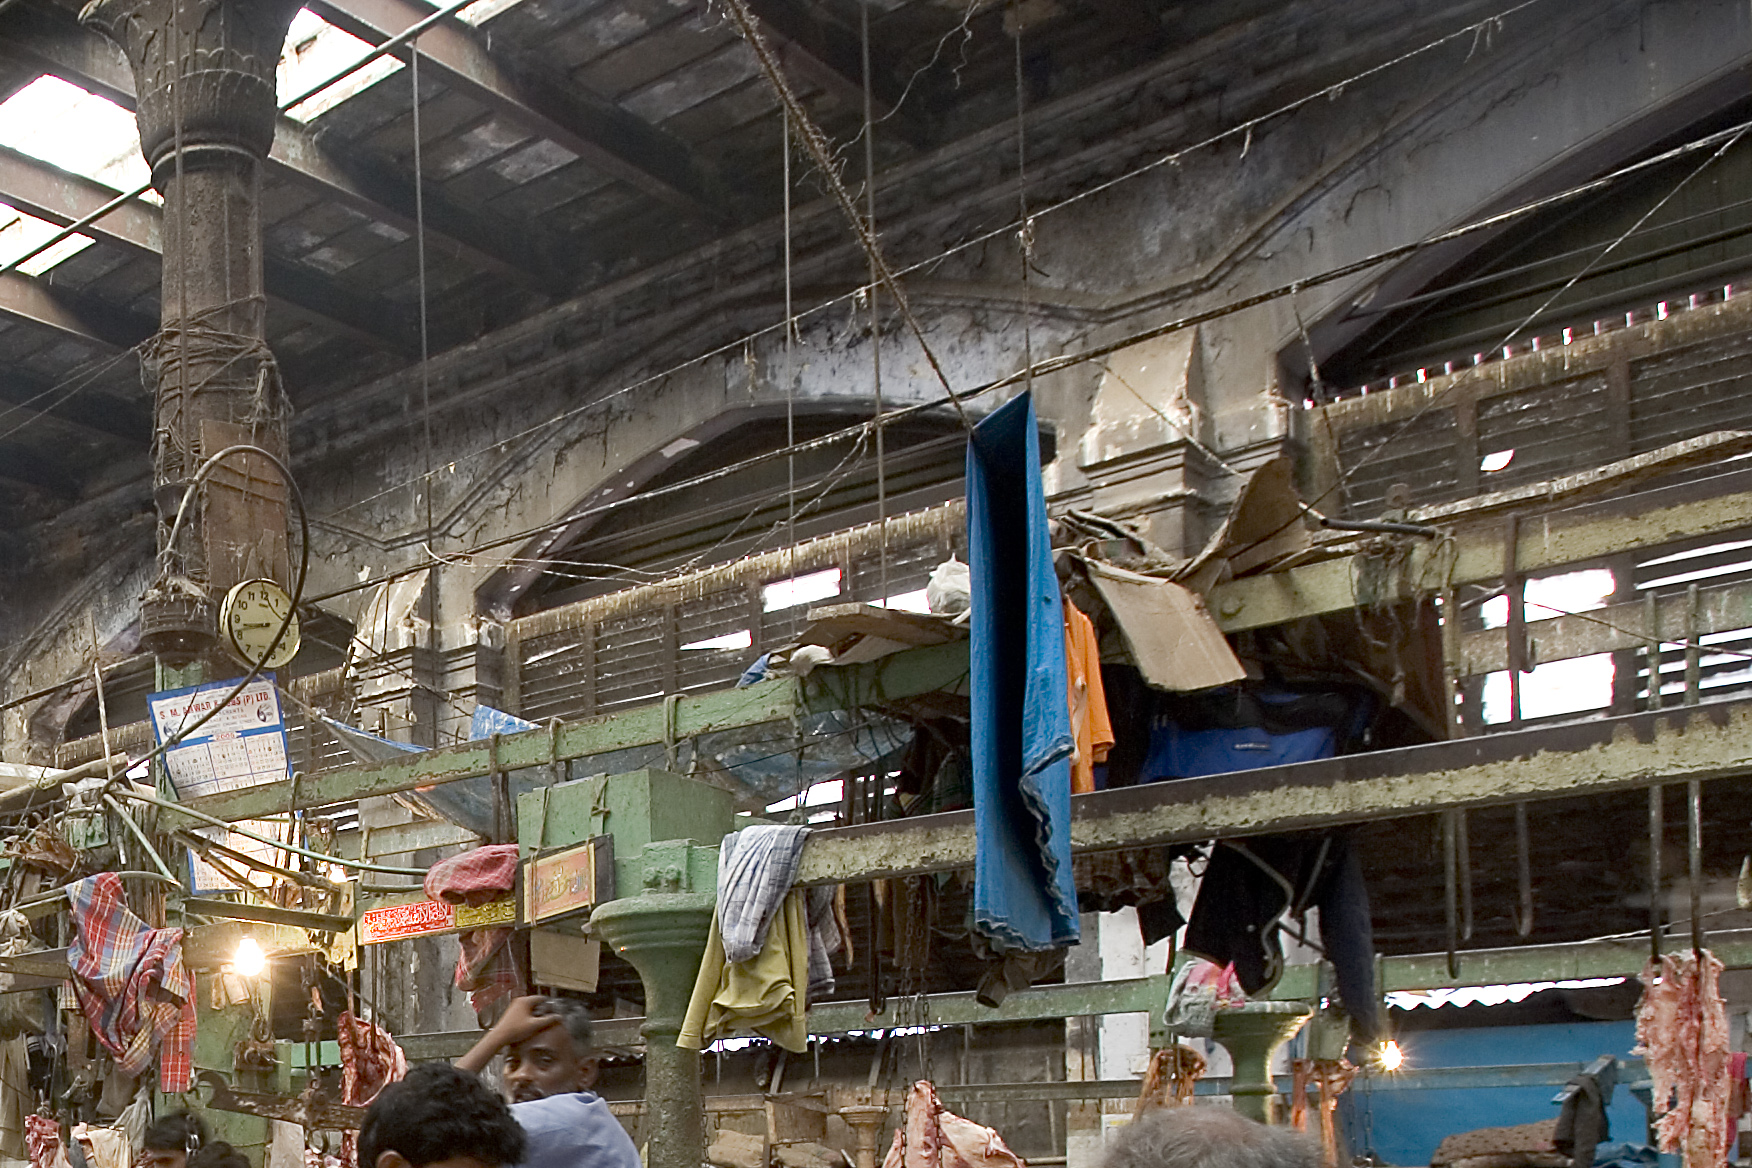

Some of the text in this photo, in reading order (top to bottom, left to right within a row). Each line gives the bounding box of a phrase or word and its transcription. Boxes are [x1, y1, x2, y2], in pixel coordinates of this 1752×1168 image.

[248, 591, 255, 600] 11
[260, 591, 268, 600] 12
[238, 600, 247, 610] 10
[235, 614, 240, 623] 9
[237, 630, 243, 640] 8
[245, 643, 251, 652] 7
[279, 642, 286, 651] 4
[243, 694, 254, 706] (P)
